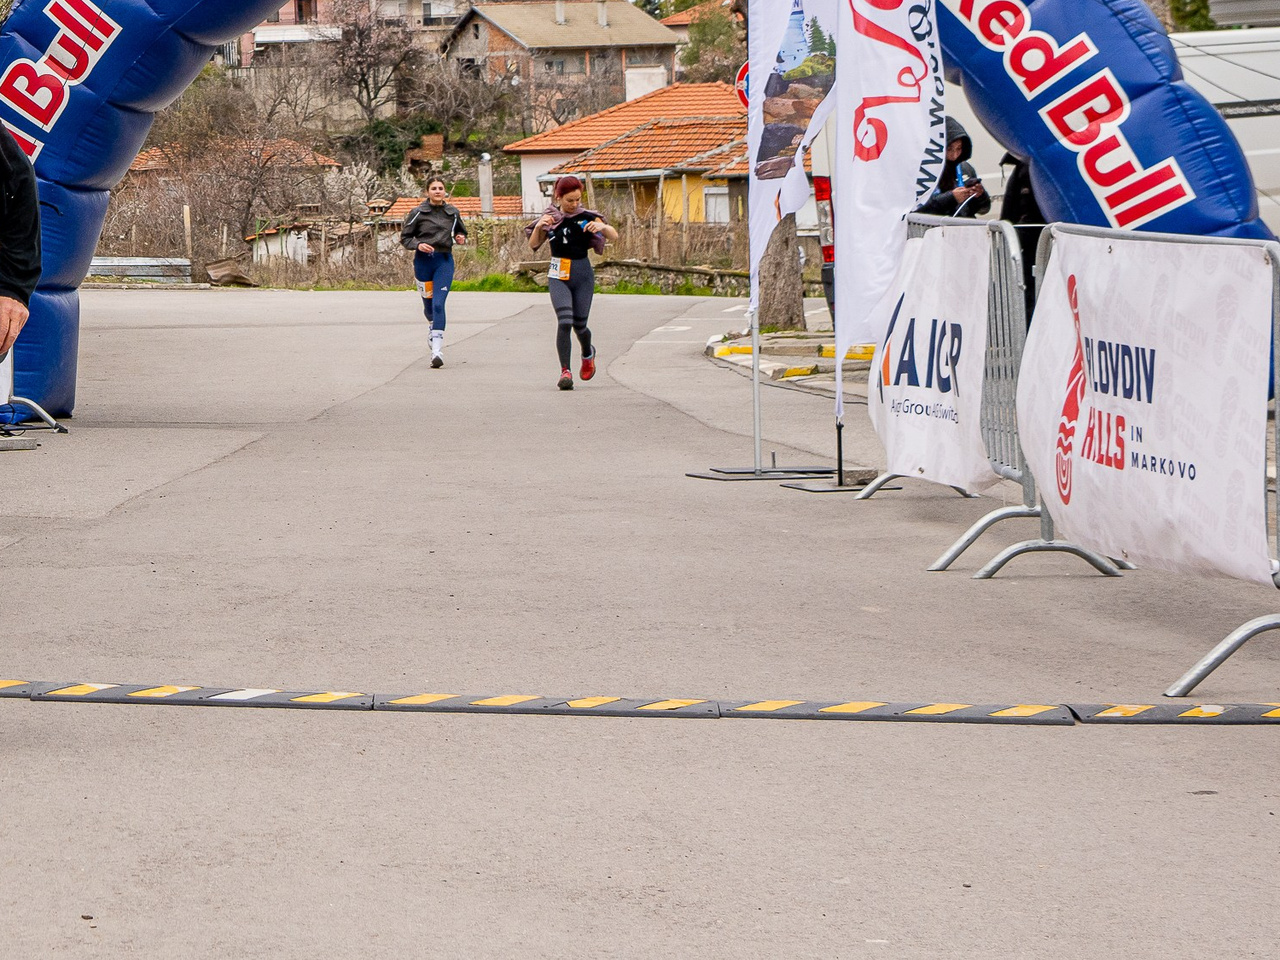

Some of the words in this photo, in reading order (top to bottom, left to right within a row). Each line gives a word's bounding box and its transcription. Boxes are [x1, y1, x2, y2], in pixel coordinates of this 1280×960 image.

[1046, 74, 1188, 229] Bull
[1084, 336, 1156, 404] PLOVDIV
[1131, 425, 1143, 443] IN
[1131, 451, 1196, 481] MARKOVO
